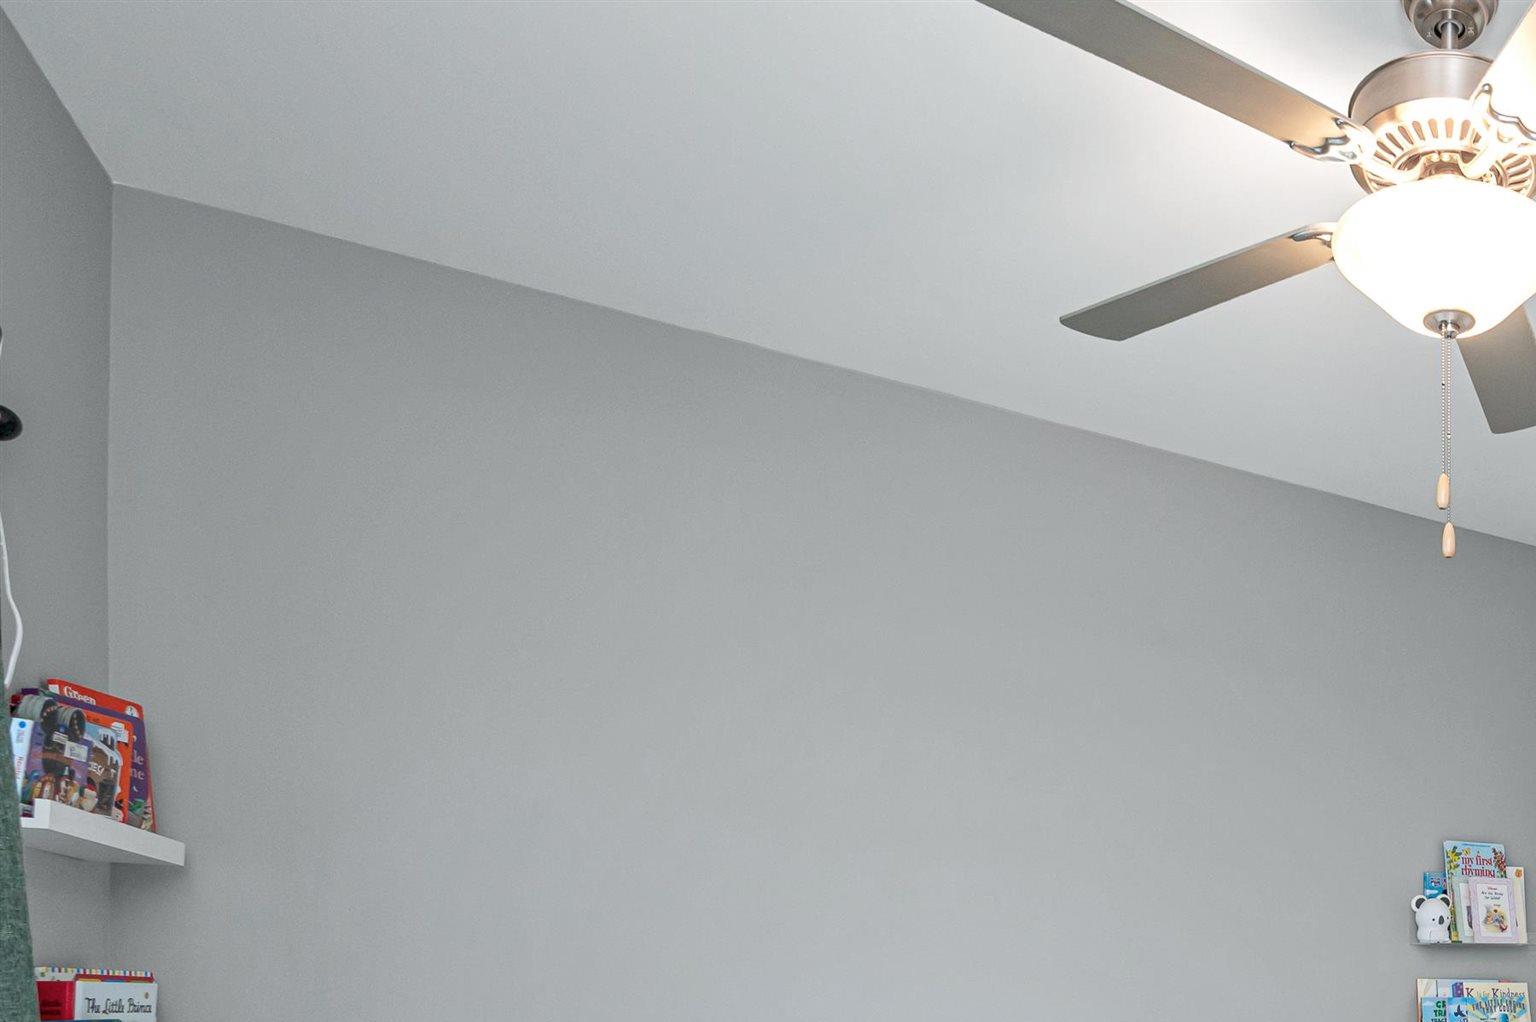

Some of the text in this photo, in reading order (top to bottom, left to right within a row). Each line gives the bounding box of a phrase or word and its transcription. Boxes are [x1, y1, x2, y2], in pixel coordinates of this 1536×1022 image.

[1461, 854, 1493, 867] my first
[1461, 865, 1496, 878] rhyming
[1465, 987, 1474, 998] K
[1491, 987, 1525, 999] Kindness
[85, 997, 153, 1015] The Little Prince
